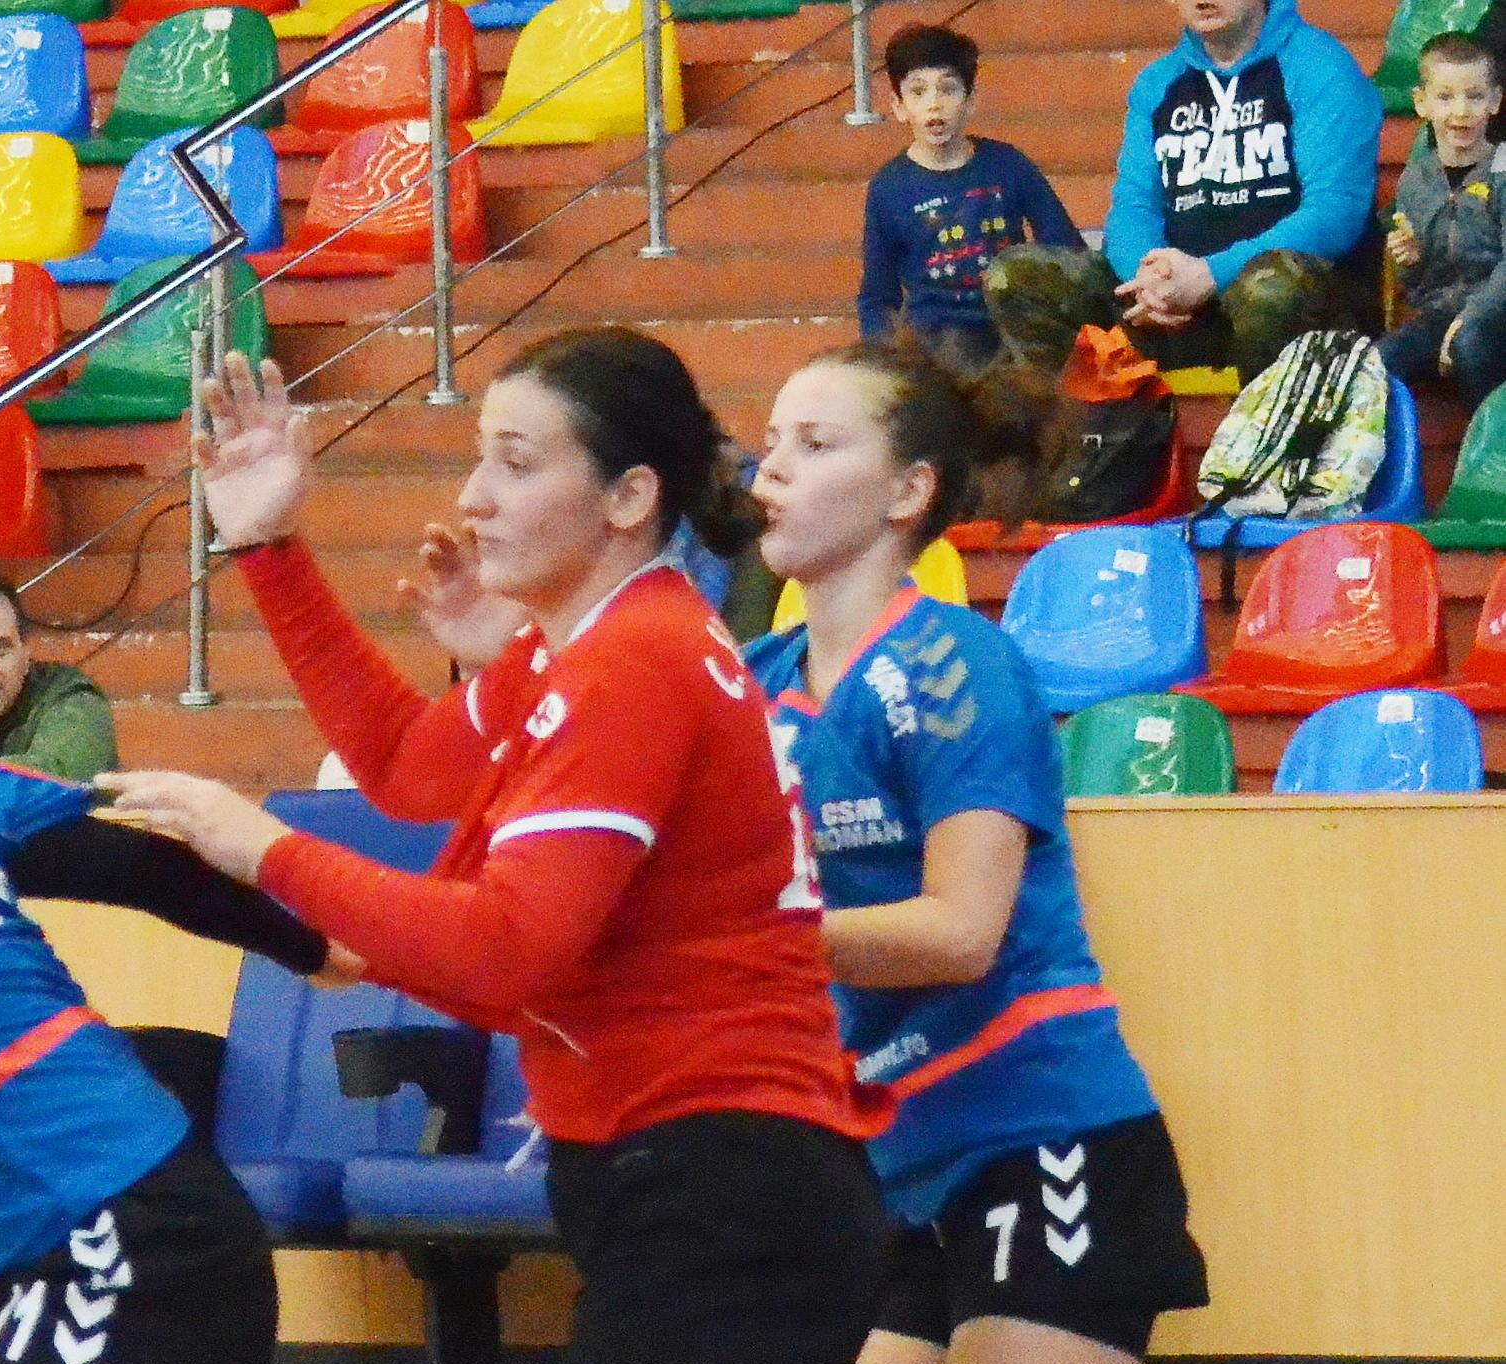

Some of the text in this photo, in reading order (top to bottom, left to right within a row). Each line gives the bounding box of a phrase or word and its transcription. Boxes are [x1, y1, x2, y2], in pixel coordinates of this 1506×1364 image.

[1212, 188, 1249, 206] YEAR
[821, 797, 884, 827] GSM
[984, 1201, 1020, 1283] 7
